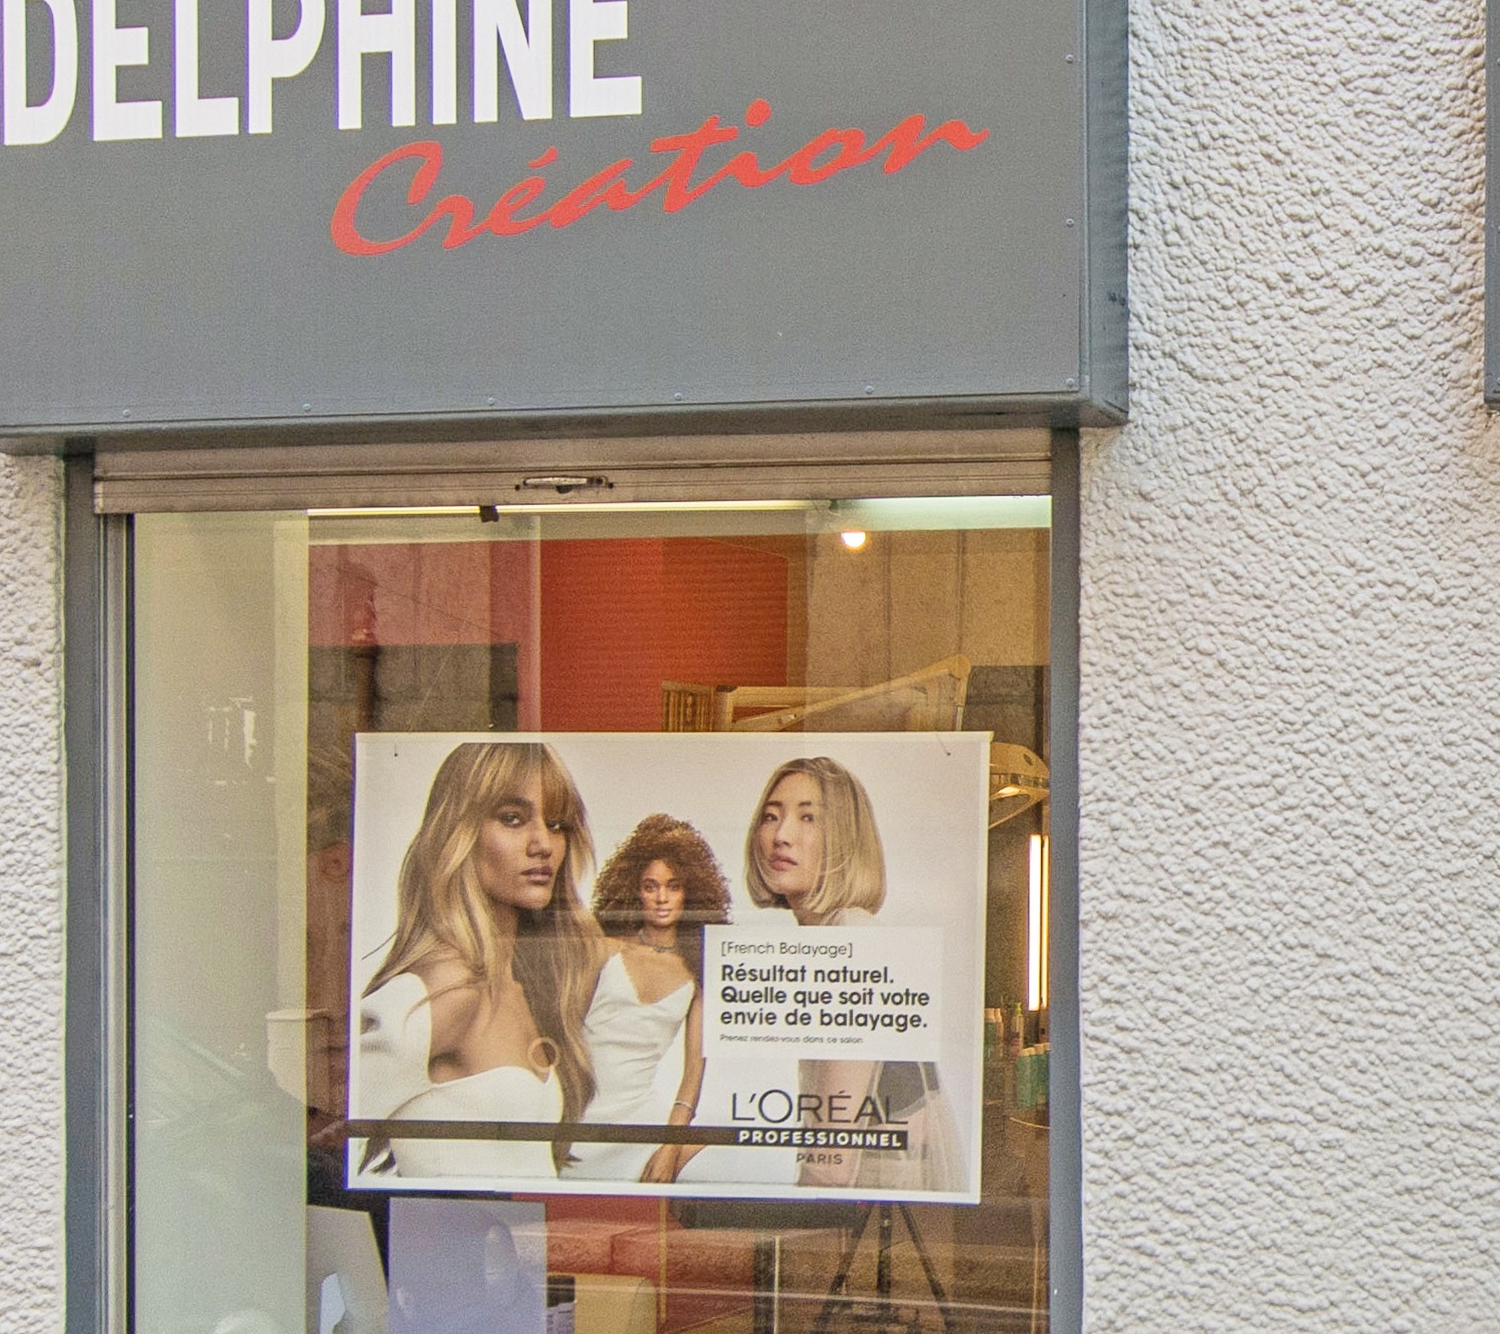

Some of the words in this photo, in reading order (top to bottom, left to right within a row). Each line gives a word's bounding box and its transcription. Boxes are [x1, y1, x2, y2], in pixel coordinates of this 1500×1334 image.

[329, 98, 991, 258] Création
[779, 941, 853, 959] Balayage]
[721, 963, 806, 984] Résultat
[813, 966, 894, 985] naturel.
[721, 986, 788, 1005] Quelle
[793, 990, 835, 1009] que
[839, 987, 875, 1006] soit
[880, 989, 930, 1007] votre
[721, 1008, 777, 1026] envie
[785, 1009, 812, 1027] de
[820, 1009, 929, 1032] balayage.
[731, 1088, 909, 1126] L'ORÉAL
[739, 1129, 903, 1148] PROFESSIONNEL
[796, 1152, 844, 1165] PARIS
